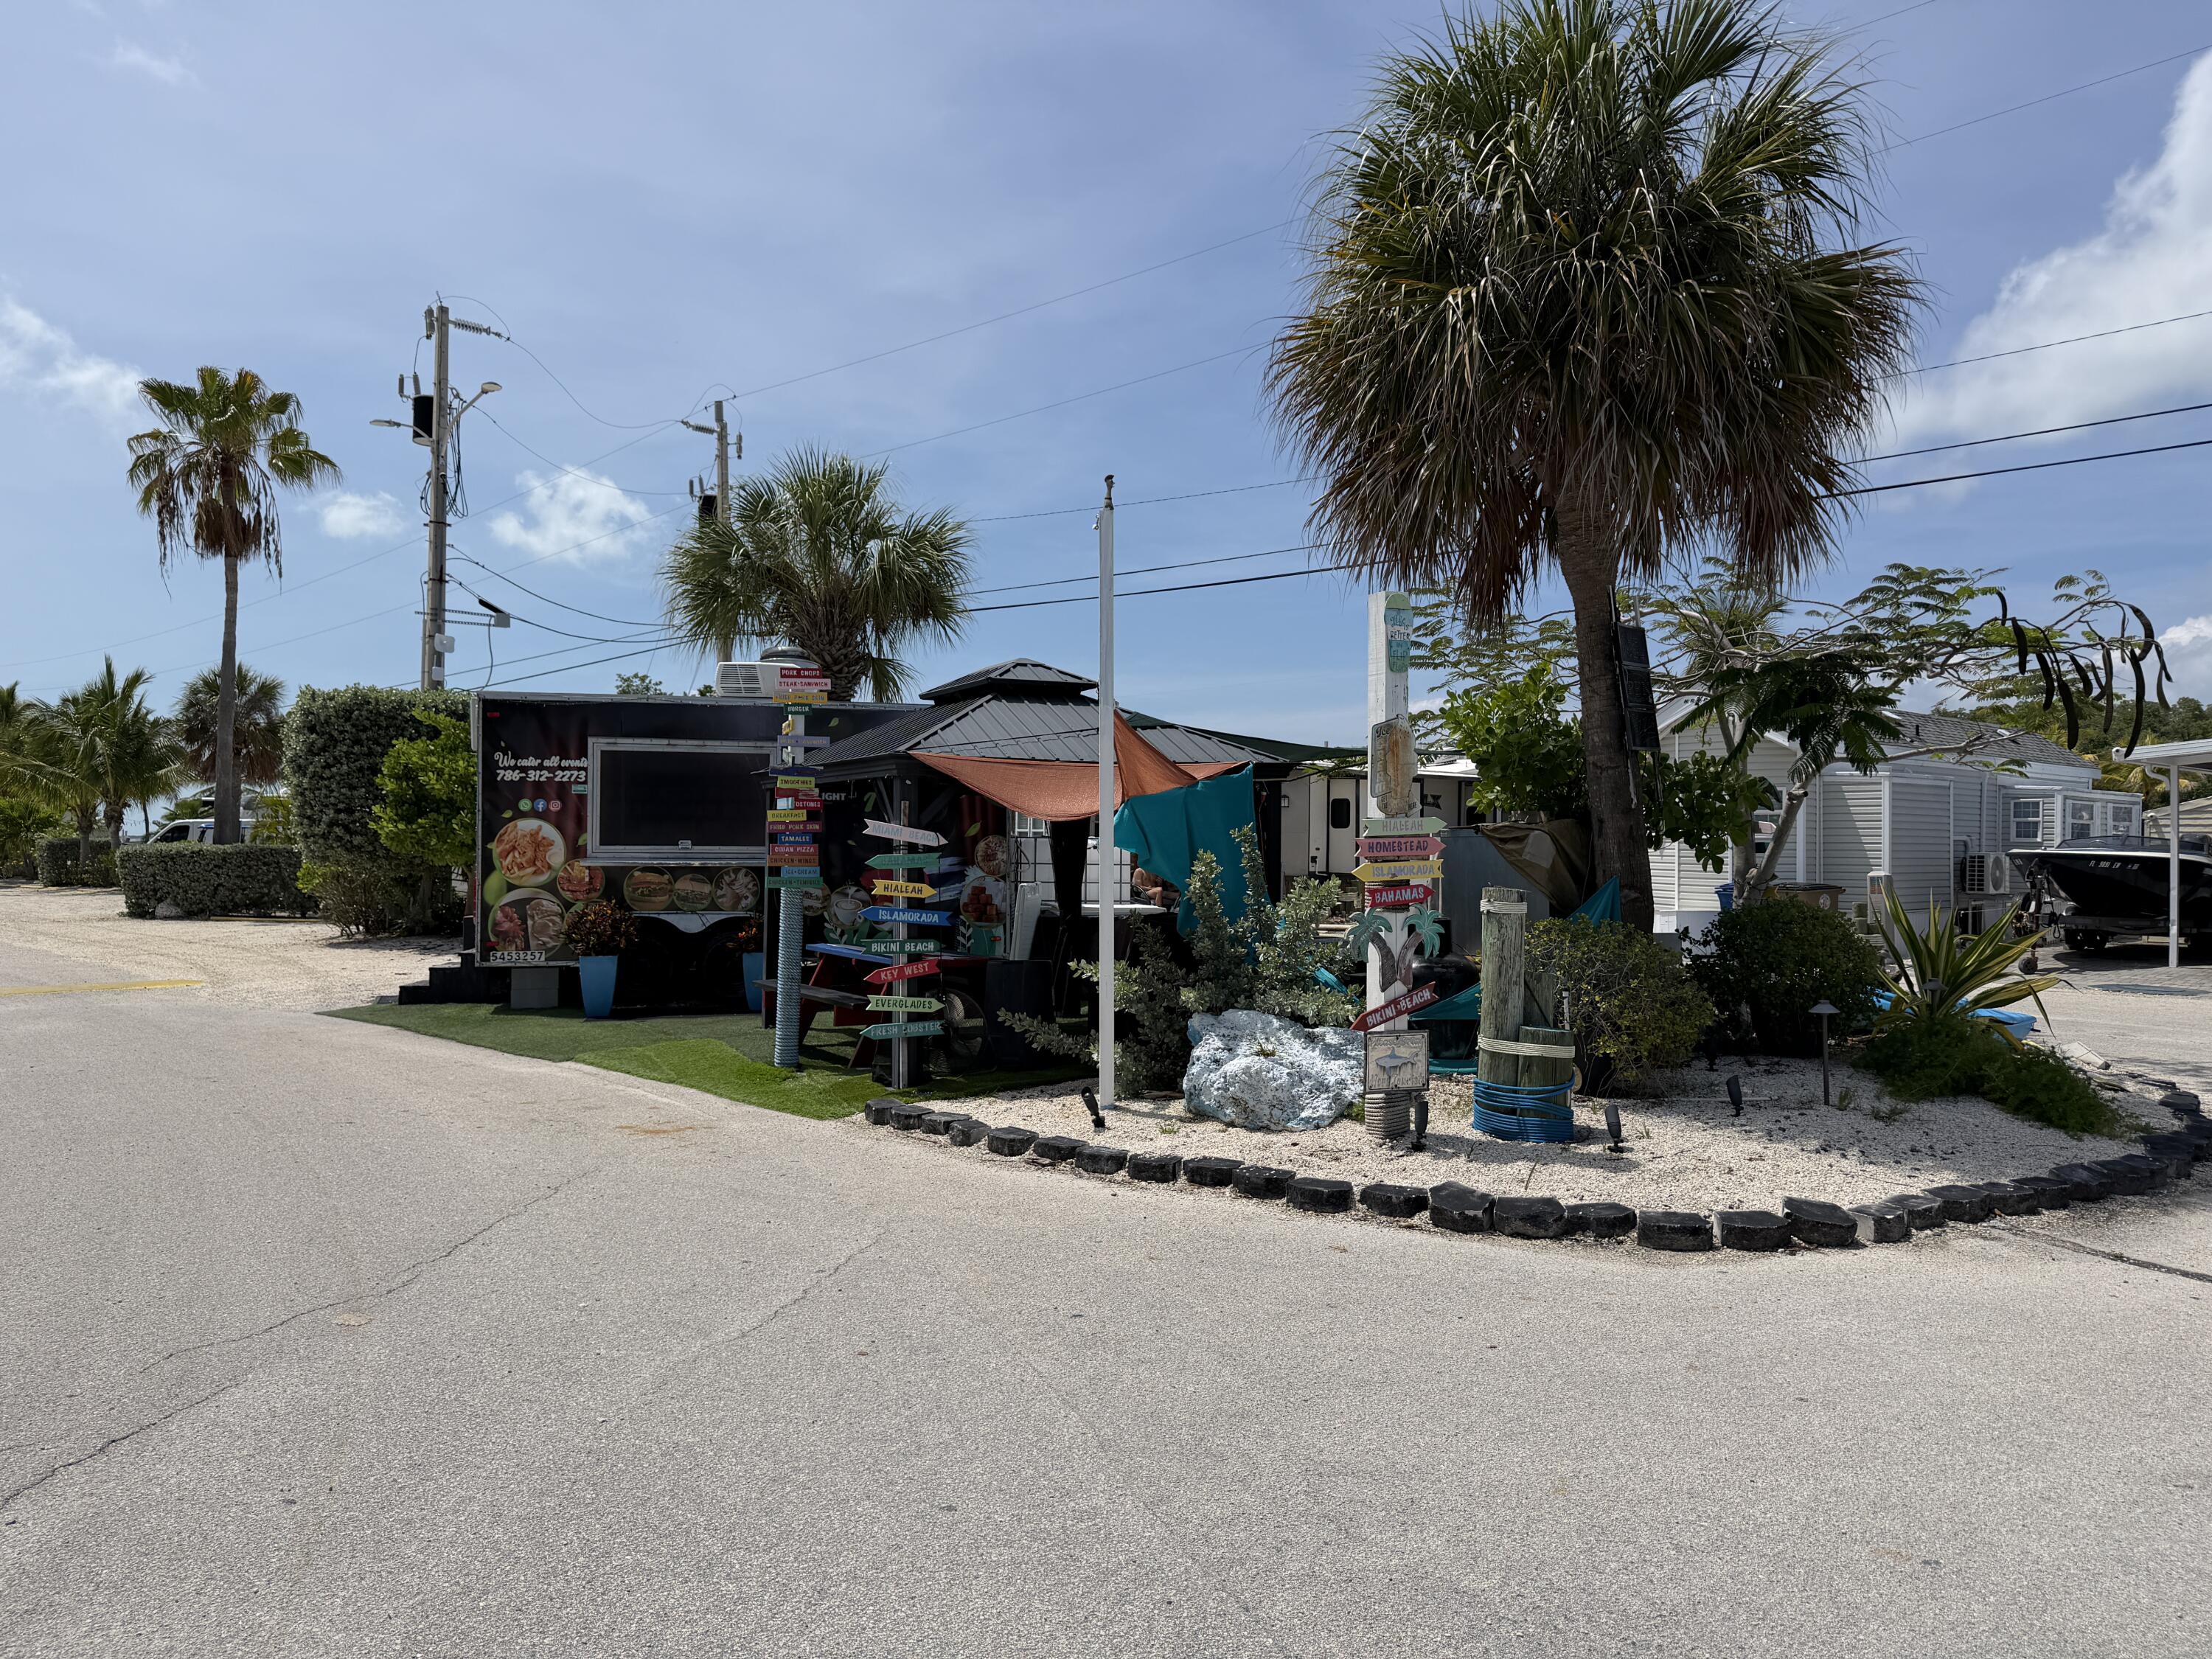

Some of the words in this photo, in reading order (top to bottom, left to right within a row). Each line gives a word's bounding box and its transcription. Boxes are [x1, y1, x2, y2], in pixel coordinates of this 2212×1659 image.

[1390, 630, 1410, 640] BETTER
[494, 751, 516, 767] We
[517, 756, 541, 767] cater
[543, 756, 560, 767] all
[495, 769, 586, 782] 786-312-2273
[821, 792, 846, 801] IGHT
[1382, 819, 1423, 832] HIALEAH
[872, 824, 902, 836] MIAMI
[908, 830, 937, 843] BEACH
[1368, 840, 1428, 852] HOMESTEAD
[1372, 864, 1435, 877] ISLAMORADA
[883, 883, 923, 895] HIALEAH
[1375, 887, 1424, 902] BAHAMAS
[878, 909, 939, 922] ISLAMORADA
[872, 942, 900, 952] BIKINI
[905, 942, 934, 952] BEACH
[491, 951, 543, 961] 5453257
[880, 968, 899, 981] KEY
[904, 961, 929, 975] WEST
[875, 998, 933, 1009] EVERGLADES
[1366, 1004, 1397, 1027] BIKINI
[1399, 988, 1431, 1011] BEACH
[870, 1026, 898, 1037] FRESH
[902, 1021, 941, 1034] LOBSTER
